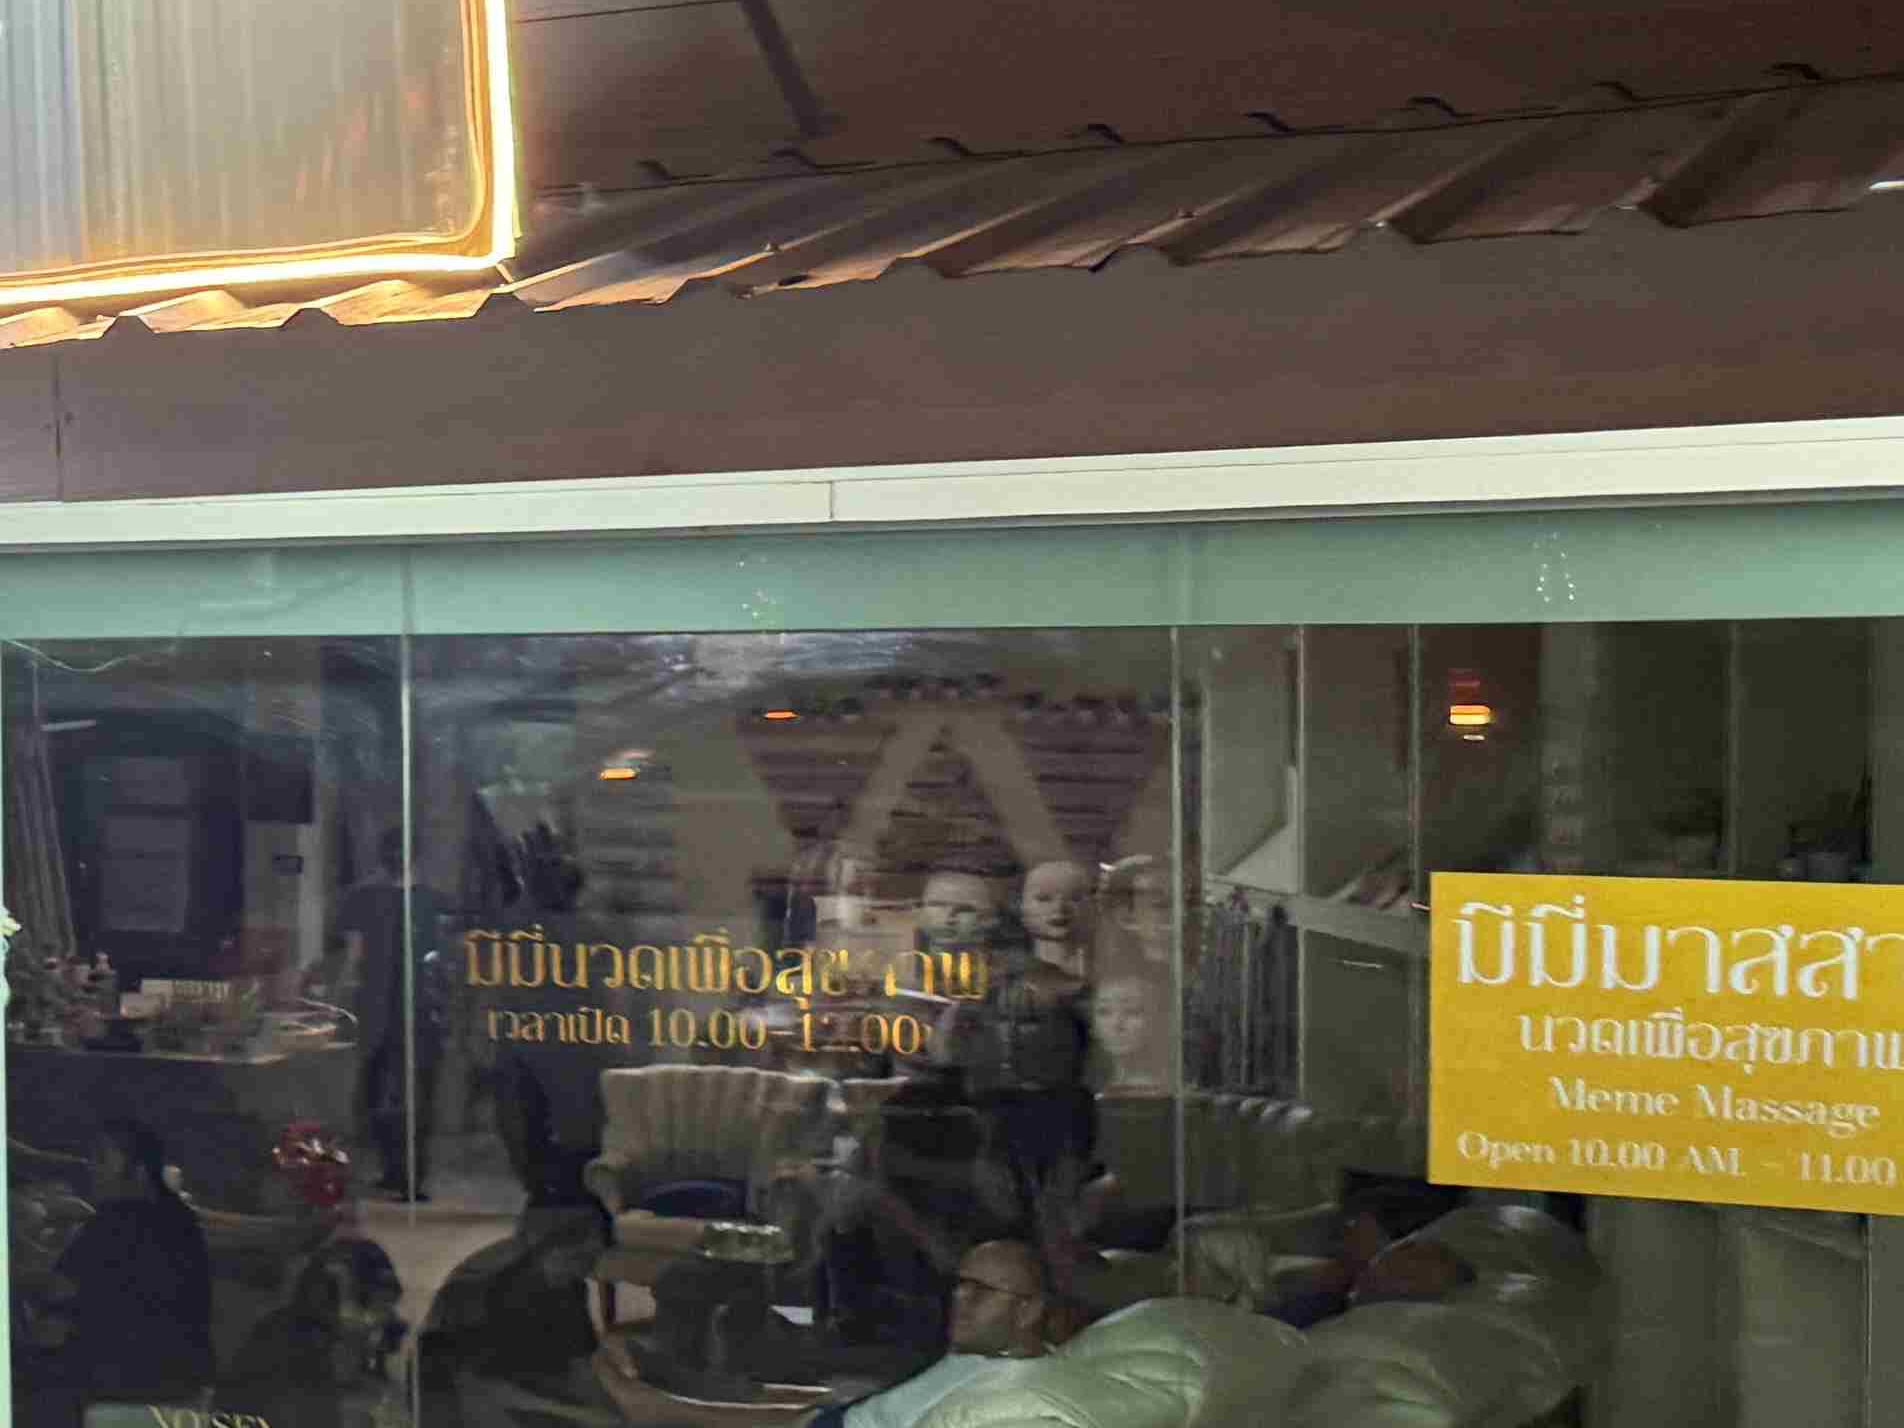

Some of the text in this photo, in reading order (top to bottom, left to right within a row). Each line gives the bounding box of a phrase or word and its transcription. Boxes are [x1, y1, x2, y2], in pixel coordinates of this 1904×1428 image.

[1549, 1075, 1881, 1140] Meme Massage
[1456, 1130, 1555, 1170] Open
[1568, 1137, 1667, 1172] 10.00
[1798, 1152, 1895, 1186] 11.00
